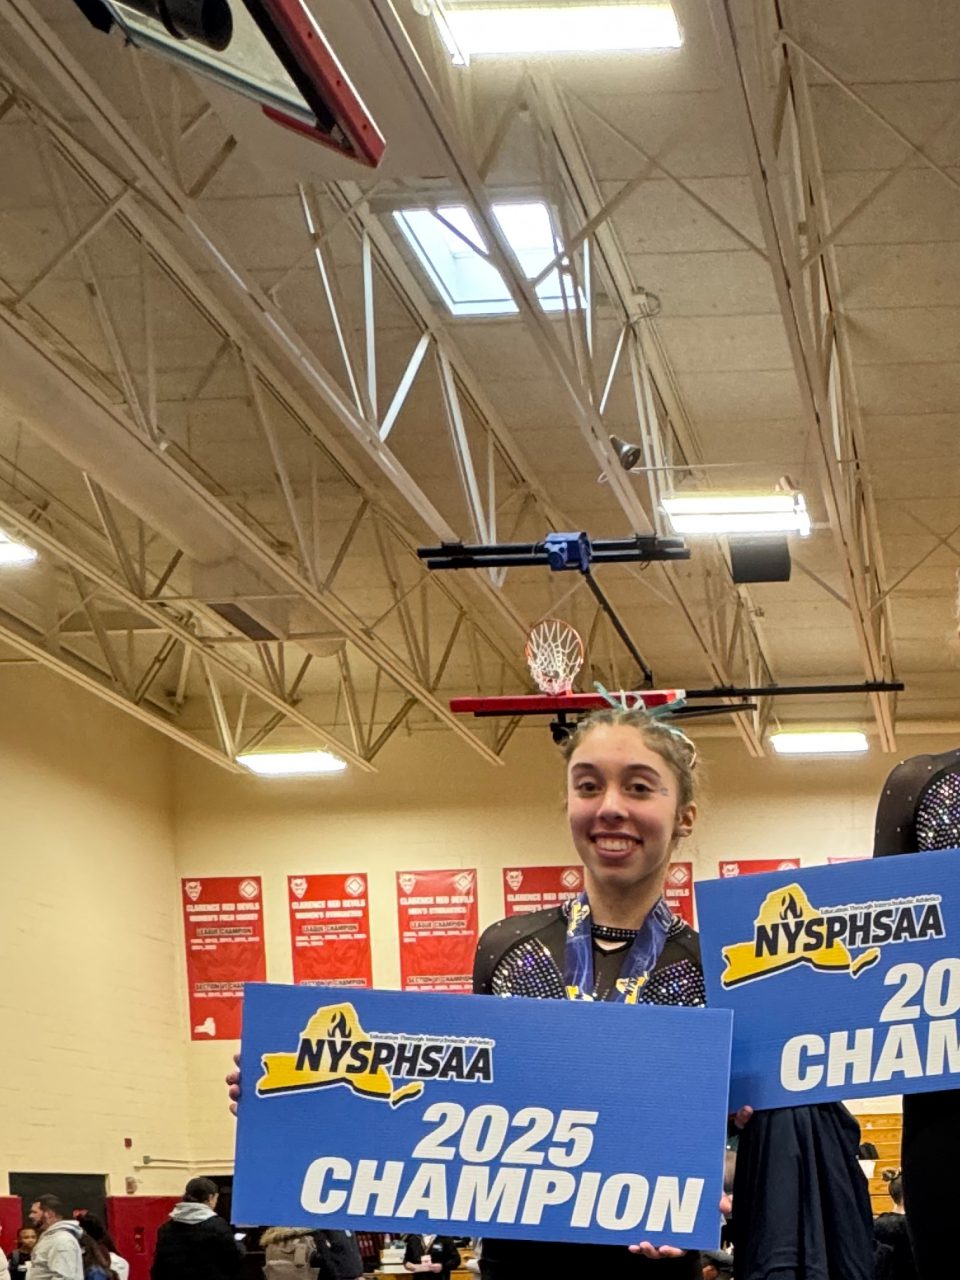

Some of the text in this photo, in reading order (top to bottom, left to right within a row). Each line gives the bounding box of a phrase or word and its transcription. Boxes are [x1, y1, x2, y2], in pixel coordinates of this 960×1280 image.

[755, 904, 944, 958] NYSPHSAA
[295, 1038, 492, 1081] NYSPHSAA
[411, 1101, 599, 1168] 2025
[300, 1156, 704, 1234] CHAMPION
